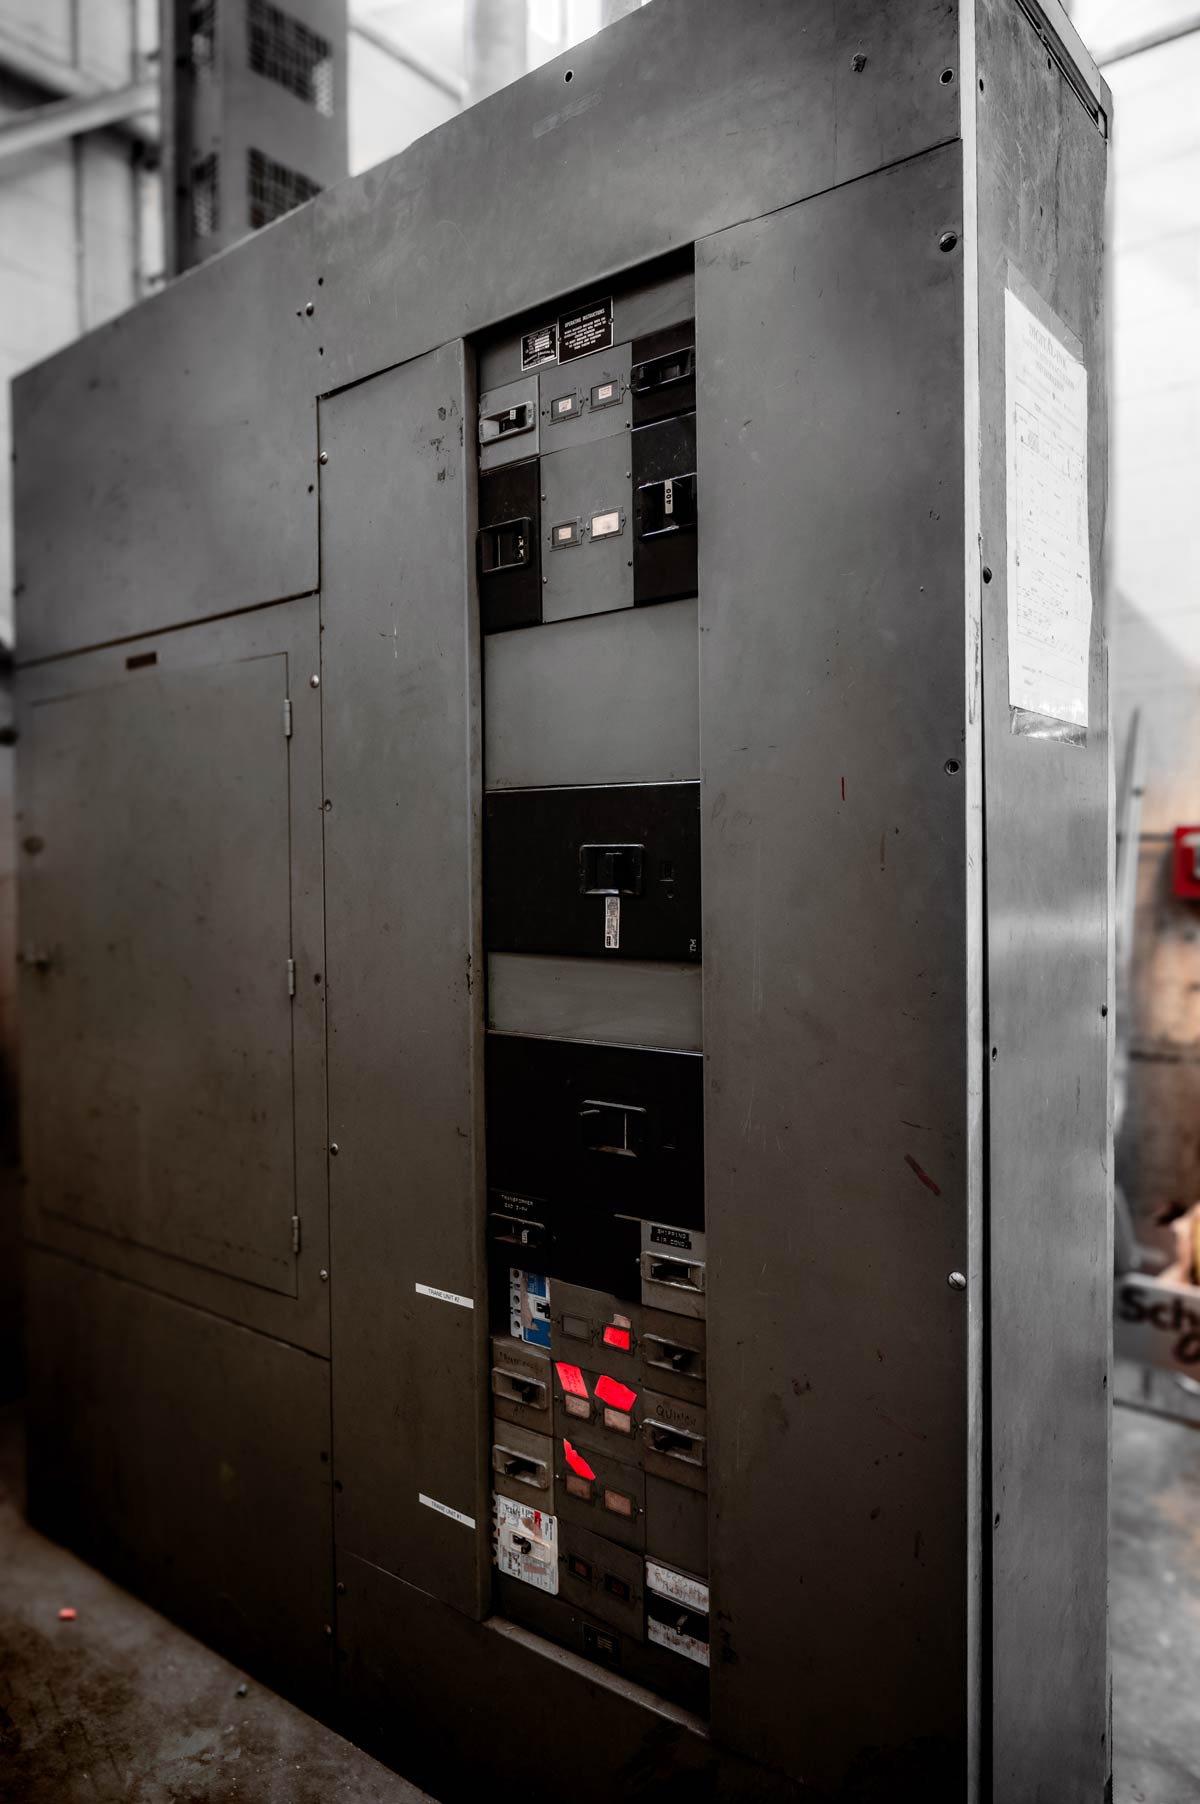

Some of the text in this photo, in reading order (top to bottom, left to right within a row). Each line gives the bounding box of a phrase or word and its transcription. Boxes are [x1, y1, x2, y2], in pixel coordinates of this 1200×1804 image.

[656, 1228, 687, 1239] SHIPPING
[428, 1288, 443, 1298] TRANE
[443, 1293, 454, 1301] UNIT
